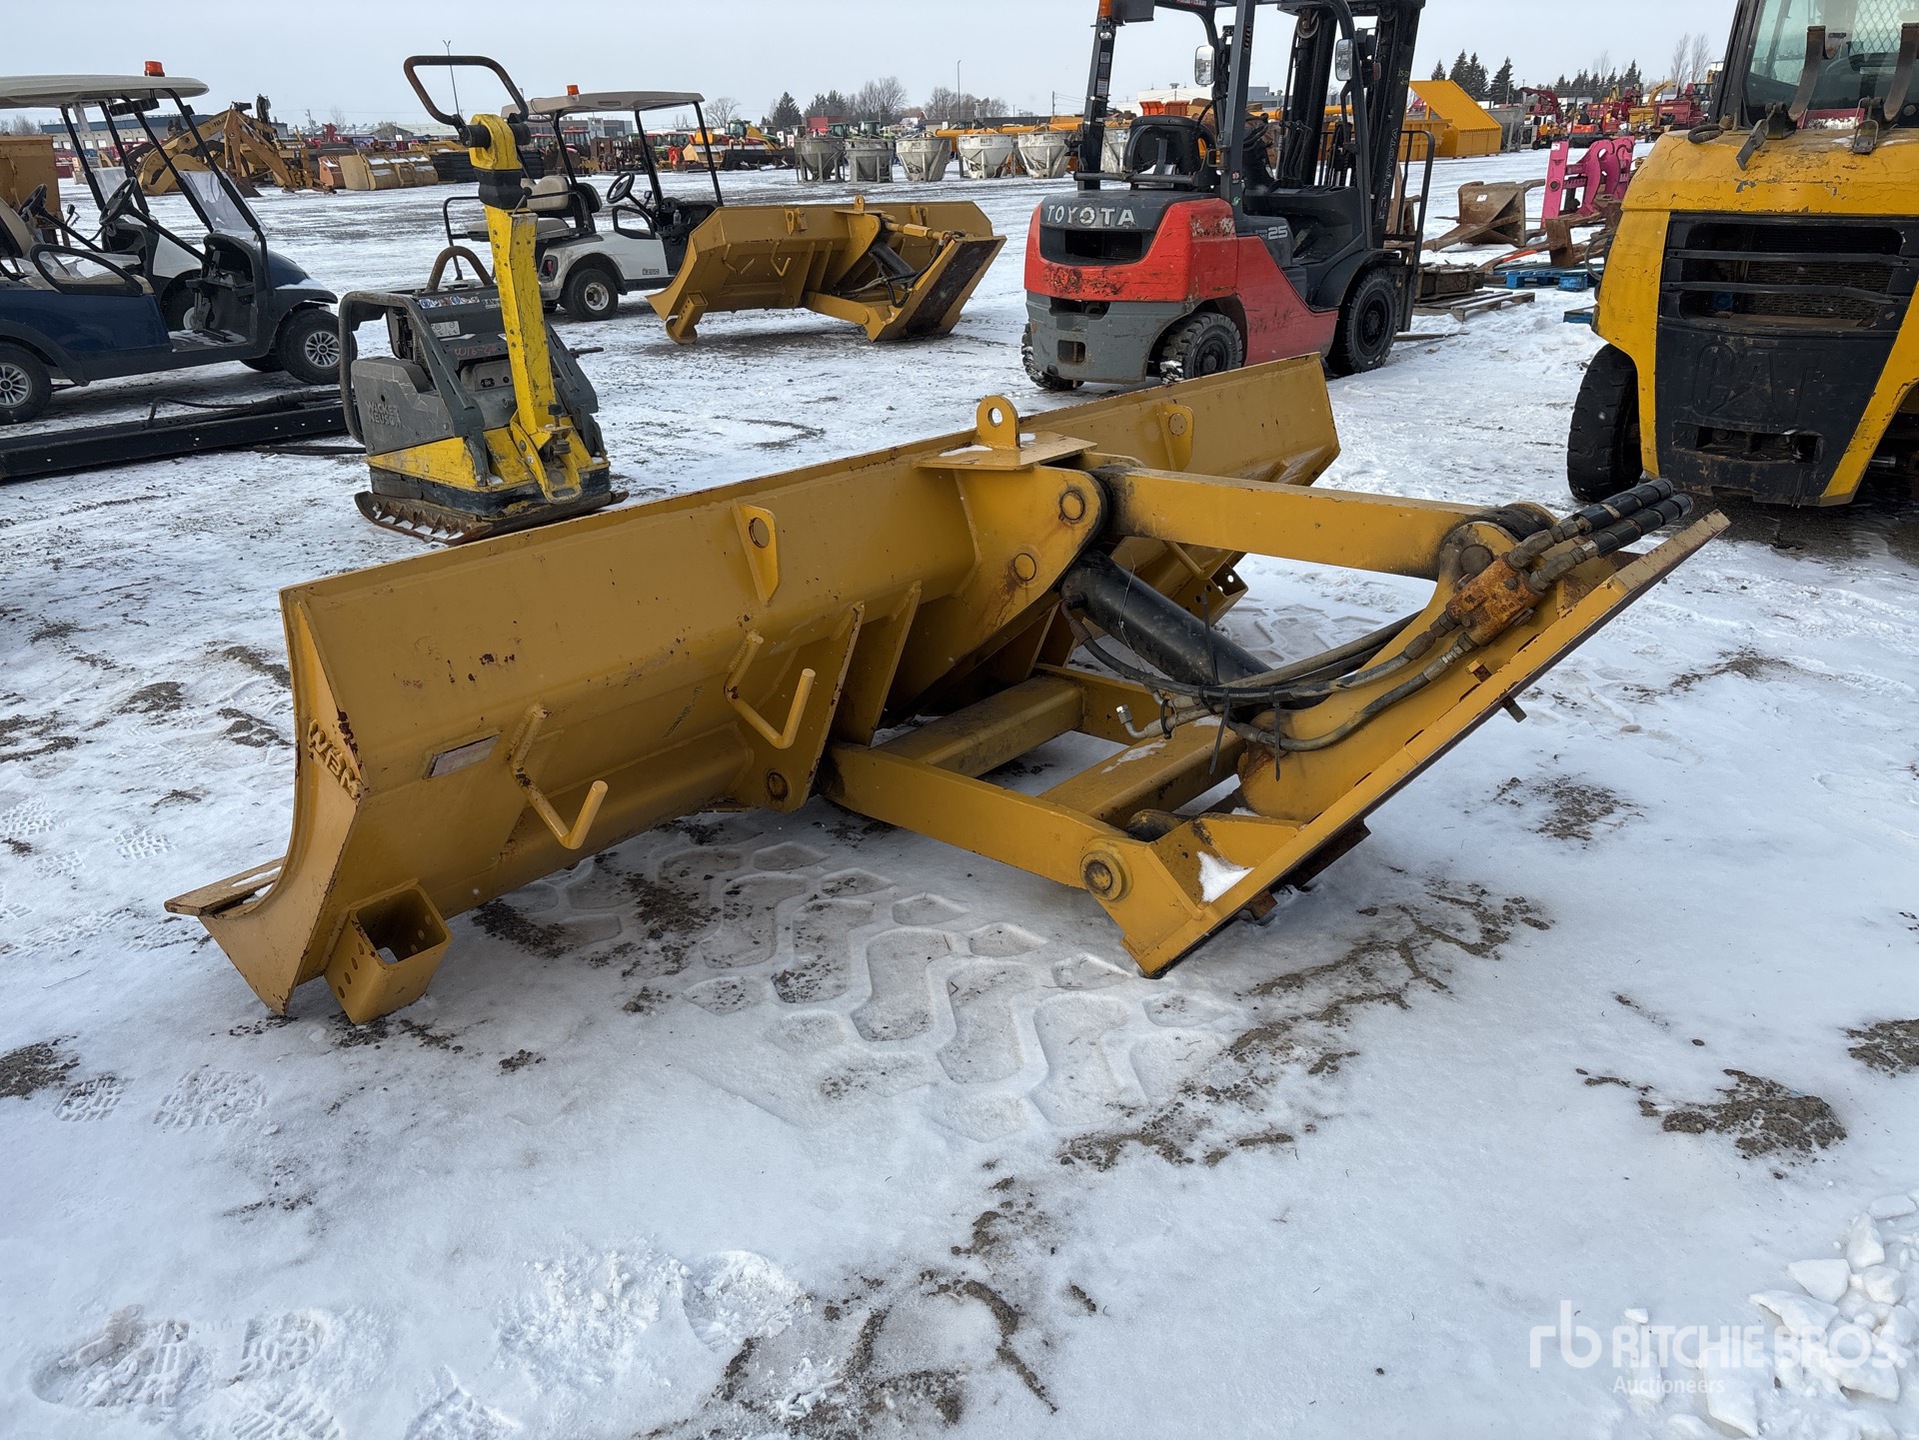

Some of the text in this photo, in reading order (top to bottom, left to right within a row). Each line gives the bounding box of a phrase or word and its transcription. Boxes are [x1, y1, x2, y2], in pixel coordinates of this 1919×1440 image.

[1046, 205, 1136, 226] TOYOTA
[1267, 225, 1288, 240] 25
[364, 400, 398, 416] WACKER
